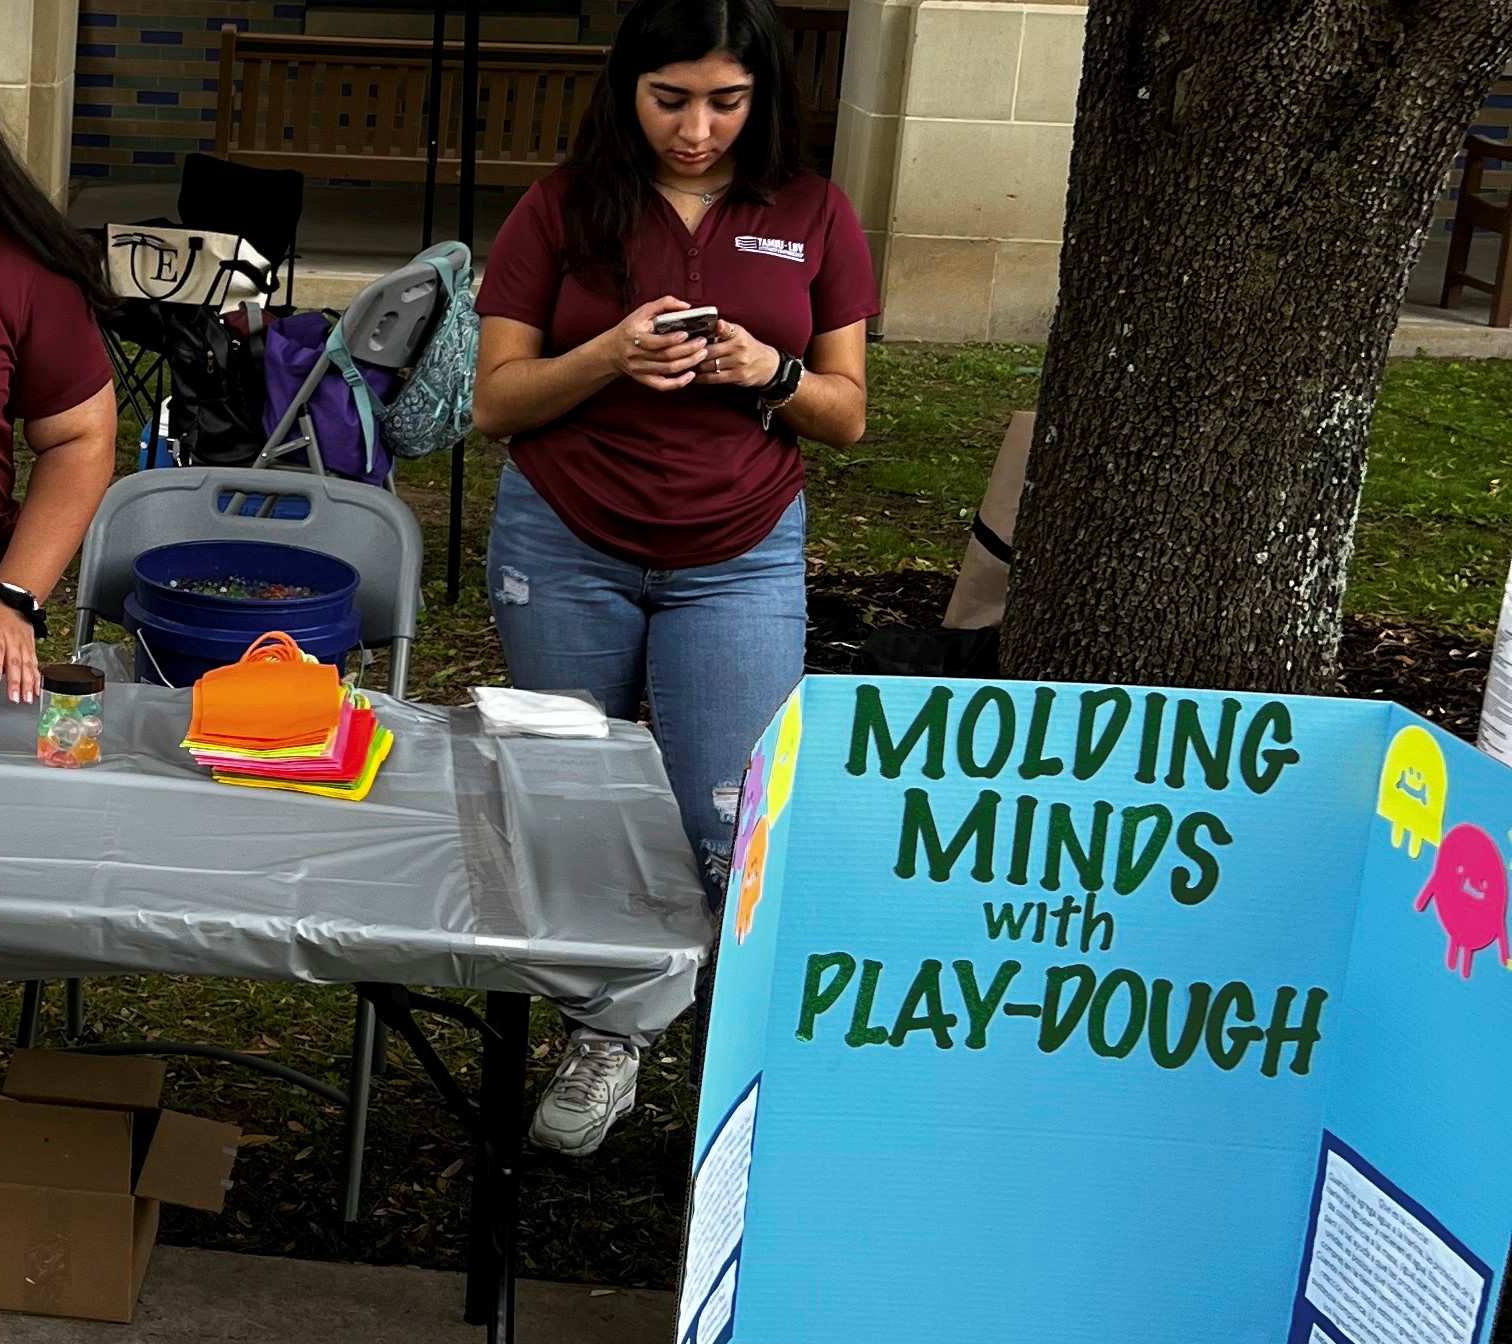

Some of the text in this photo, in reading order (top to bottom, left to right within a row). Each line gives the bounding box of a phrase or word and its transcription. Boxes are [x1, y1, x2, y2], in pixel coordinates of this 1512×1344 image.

[846, 685, 1300, 795] MOLDING
[894, 787, 1233, 906] MINDS
[983, 892, 1115, 952] with
[795, 952, 1329, 1077] PLAY-DOUGH
